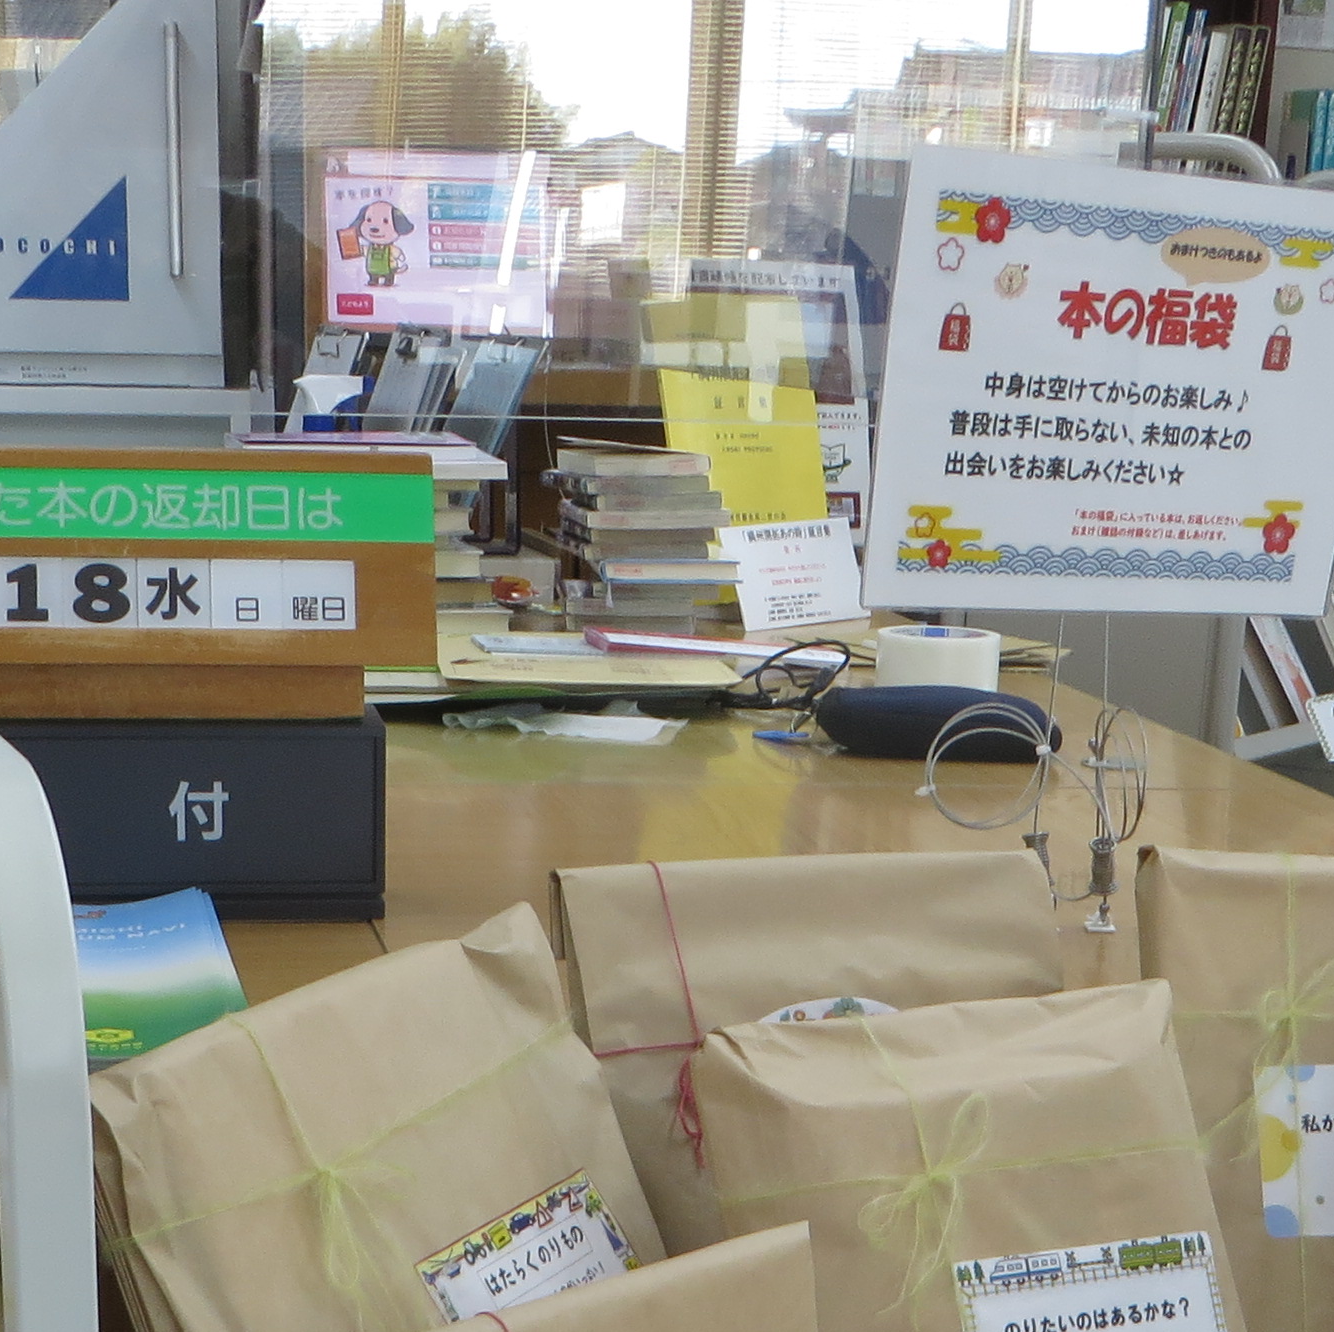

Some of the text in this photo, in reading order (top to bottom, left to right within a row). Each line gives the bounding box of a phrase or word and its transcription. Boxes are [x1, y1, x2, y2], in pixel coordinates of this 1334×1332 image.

[1170, 241, 1263, 265] おまけつきのもあるよ
[1058, 281, 1238, 349] 本の福袋
[949, 410, 1251, 450] 普段は手に取らない、未知の本との
[146, 567, 201, 621] 水
[292, 596, 347, 622] 曜日
[484, 1225, 585, 1297] はたらくのりもの
